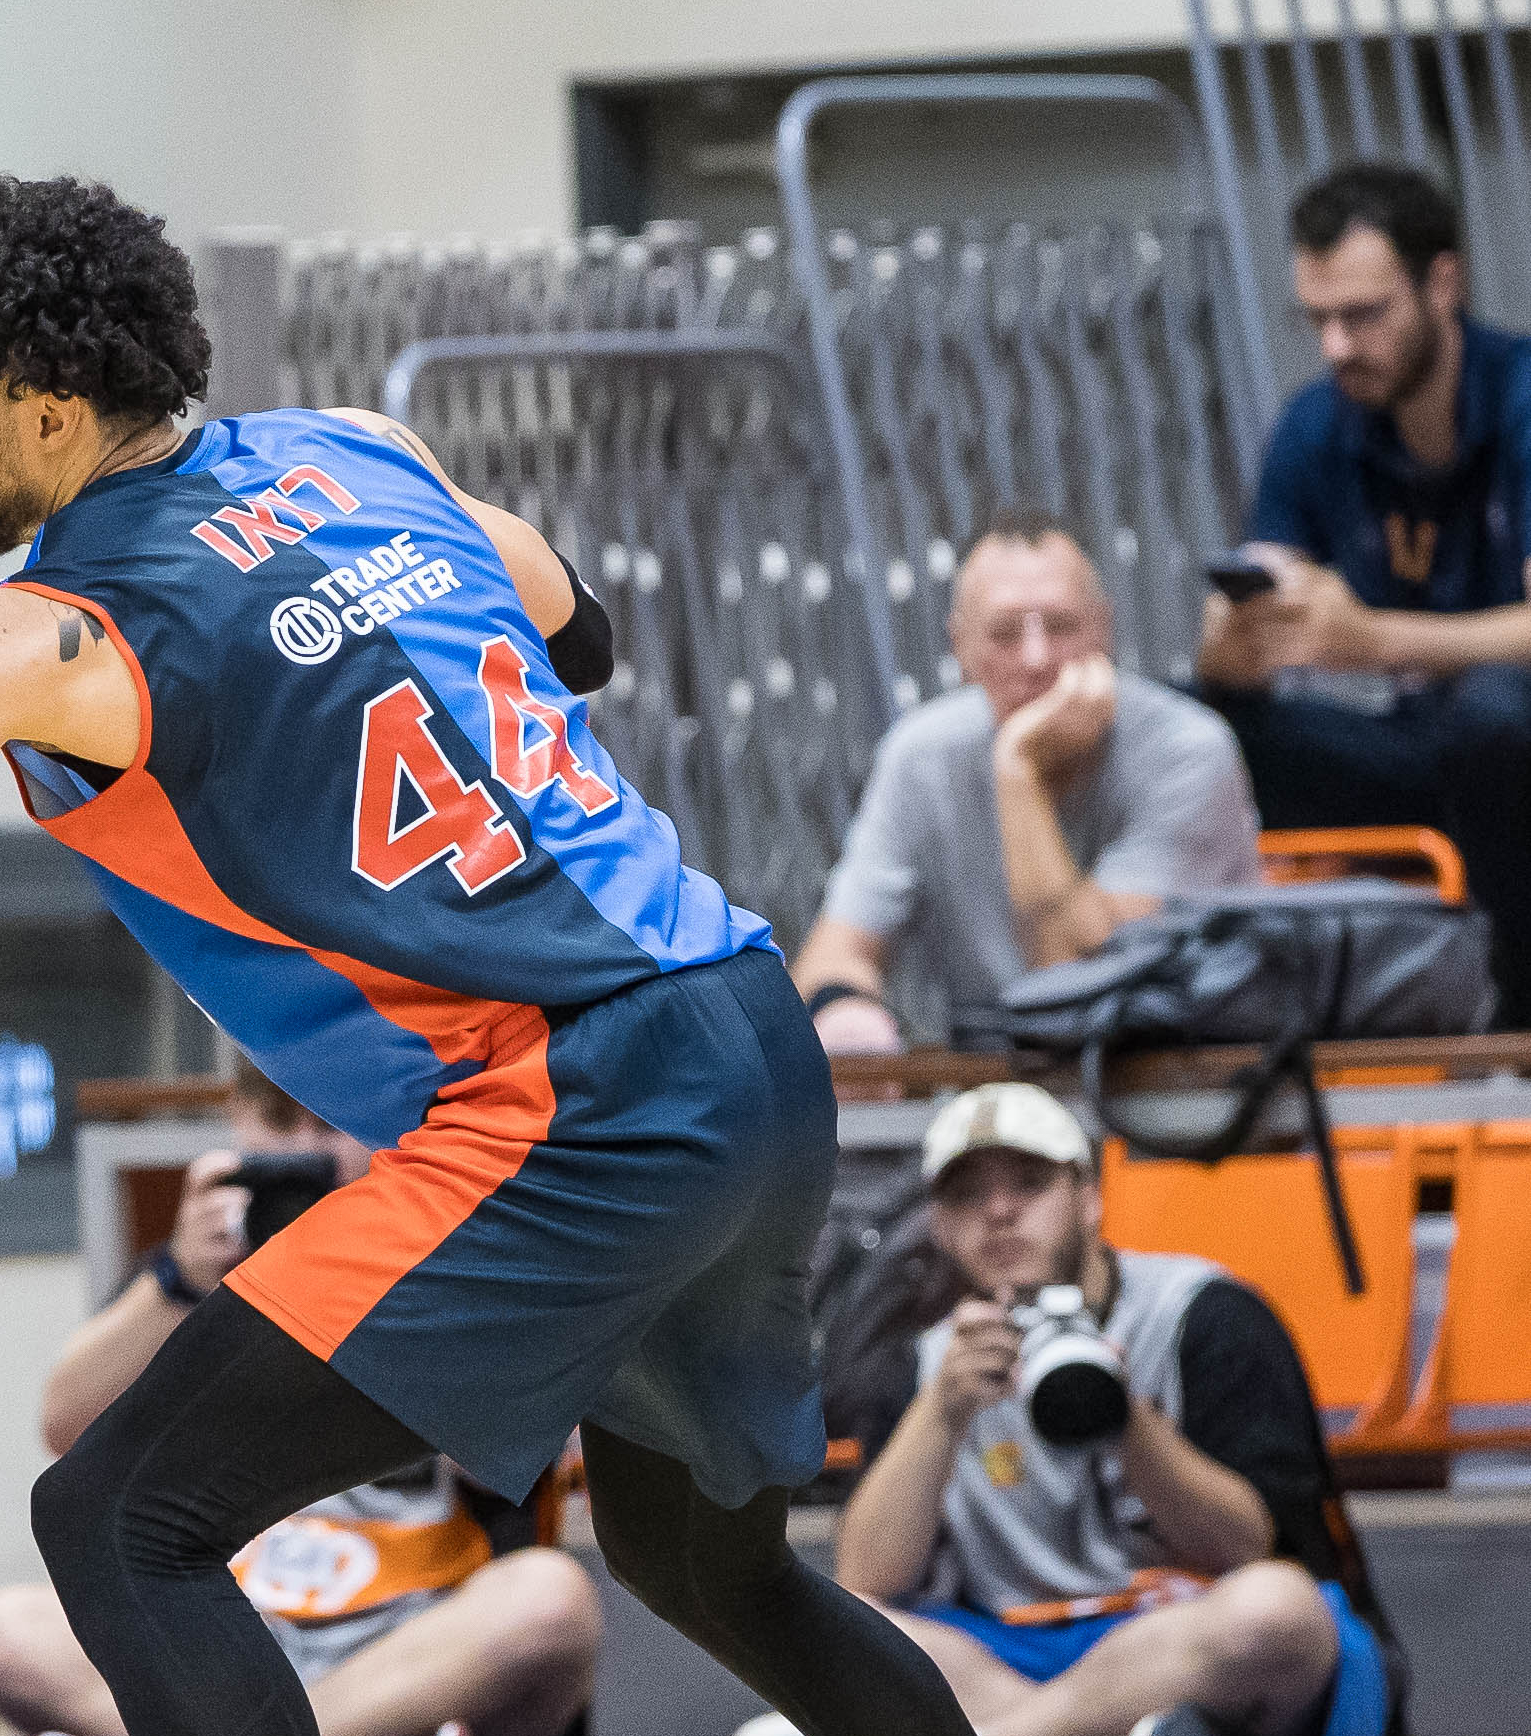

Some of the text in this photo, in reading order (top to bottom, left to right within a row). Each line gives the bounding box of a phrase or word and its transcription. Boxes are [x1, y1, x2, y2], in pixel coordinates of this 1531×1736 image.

[310, 531, 425, 607] TRADE
[341, 558, 462, 636] CENTER
[352, 634, 619, 896] 44
